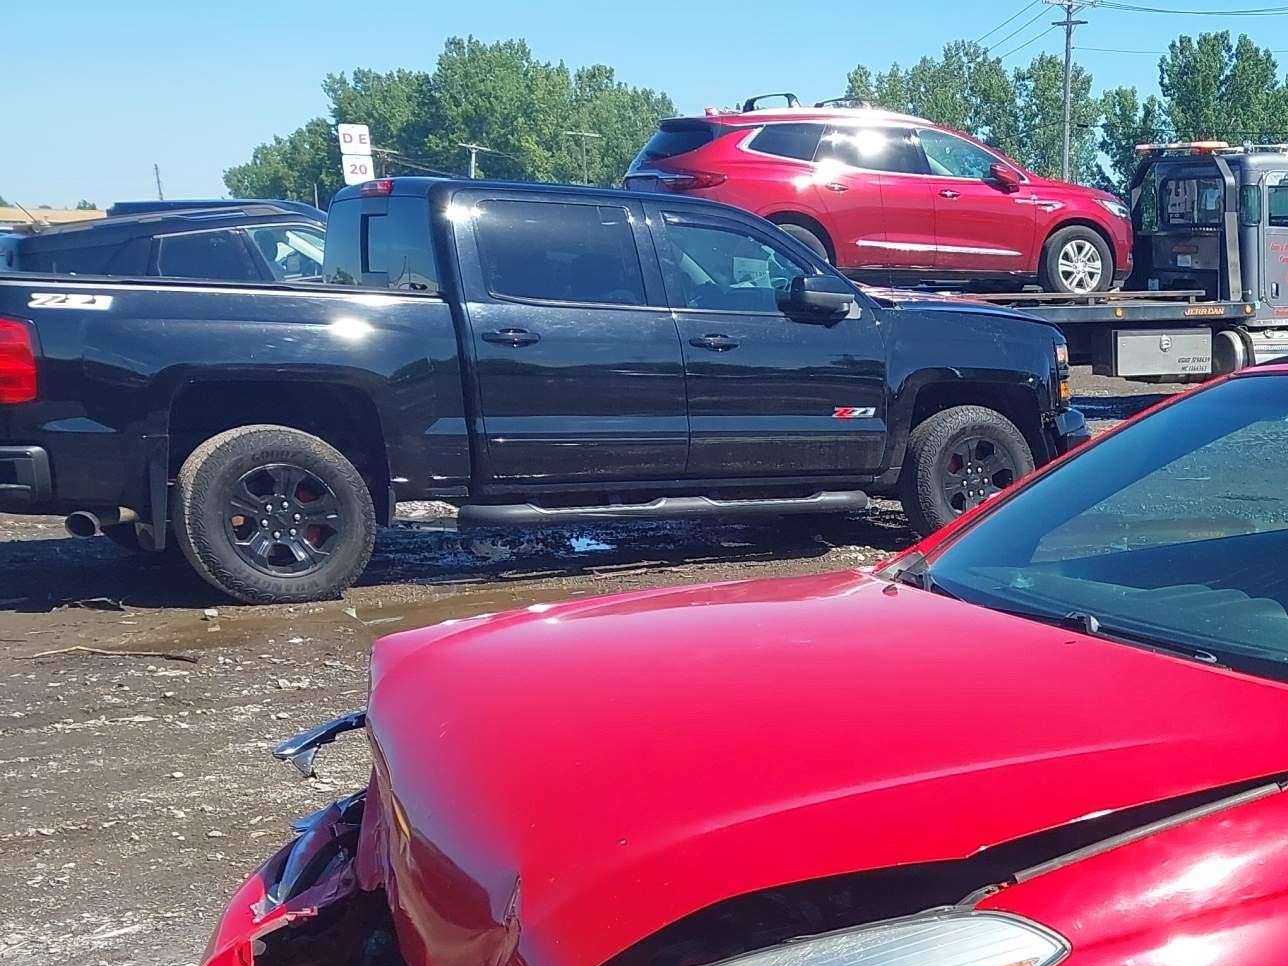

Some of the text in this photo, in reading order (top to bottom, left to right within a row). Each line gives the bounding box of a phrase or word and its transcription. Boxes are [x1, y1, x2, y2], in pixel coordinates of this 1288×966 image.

[342, 133, 367, 144] D E
[350, 164, 368, 174] 20
[832, 407, 876, 417] Z71
